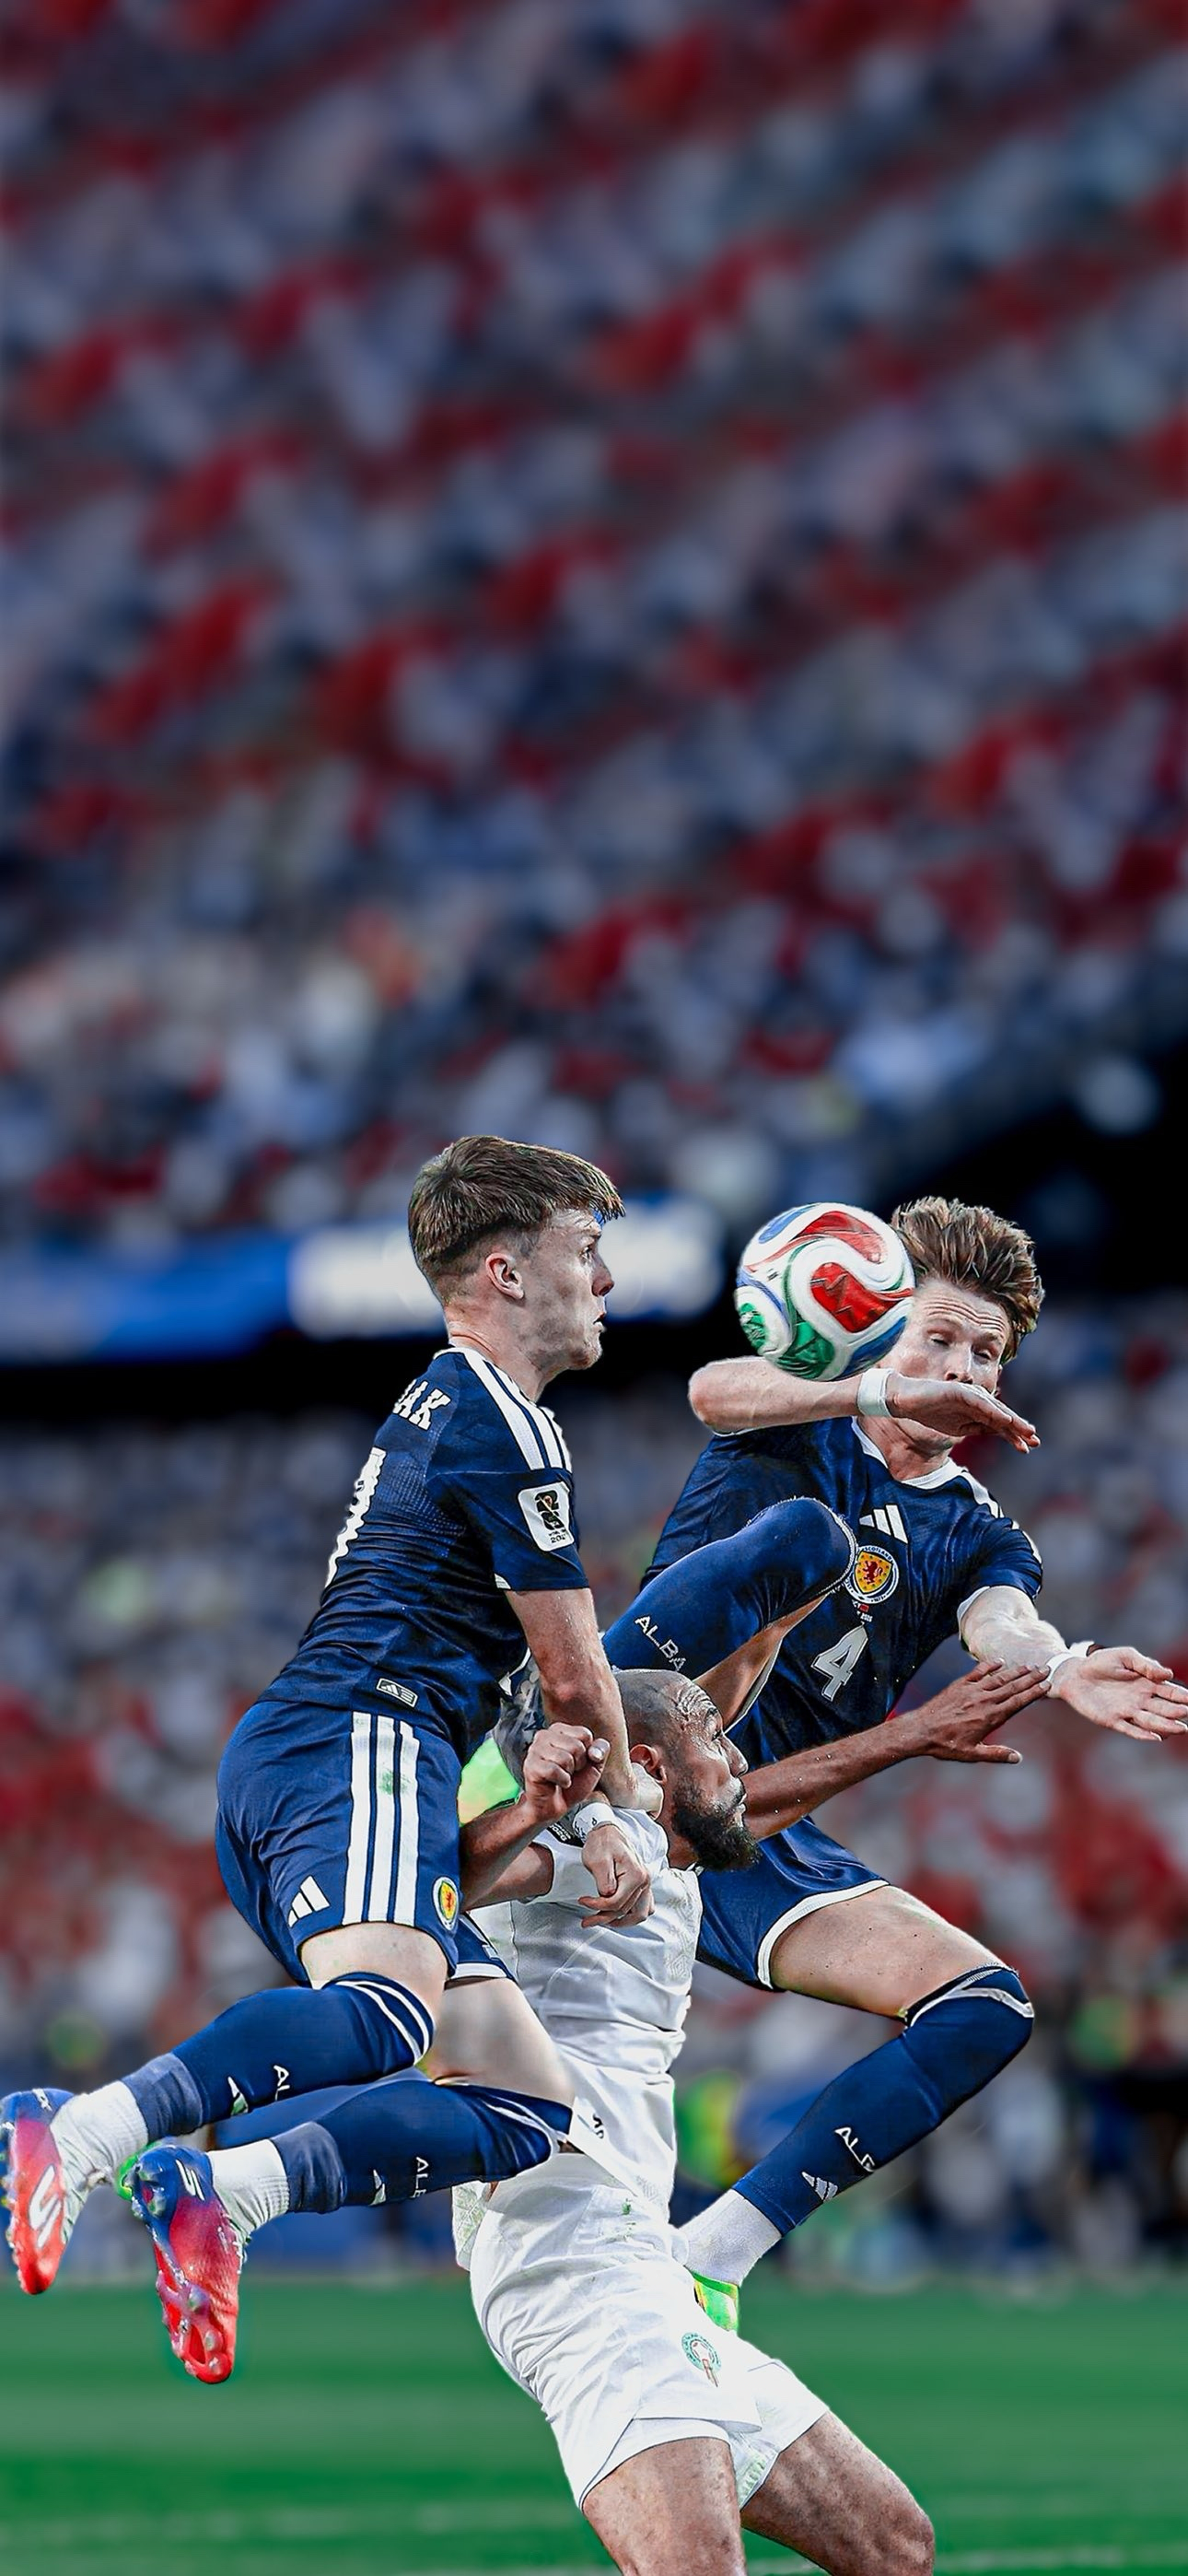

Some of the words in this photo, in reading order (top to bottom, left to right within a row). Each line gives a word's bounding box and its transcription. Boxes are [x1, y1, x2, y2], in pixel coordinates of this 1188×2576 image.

[392, 1378, 451, 1430] AK
[634, 1615, 687, 1672] ALBA
[810, 1626, 869, 1703] 4
